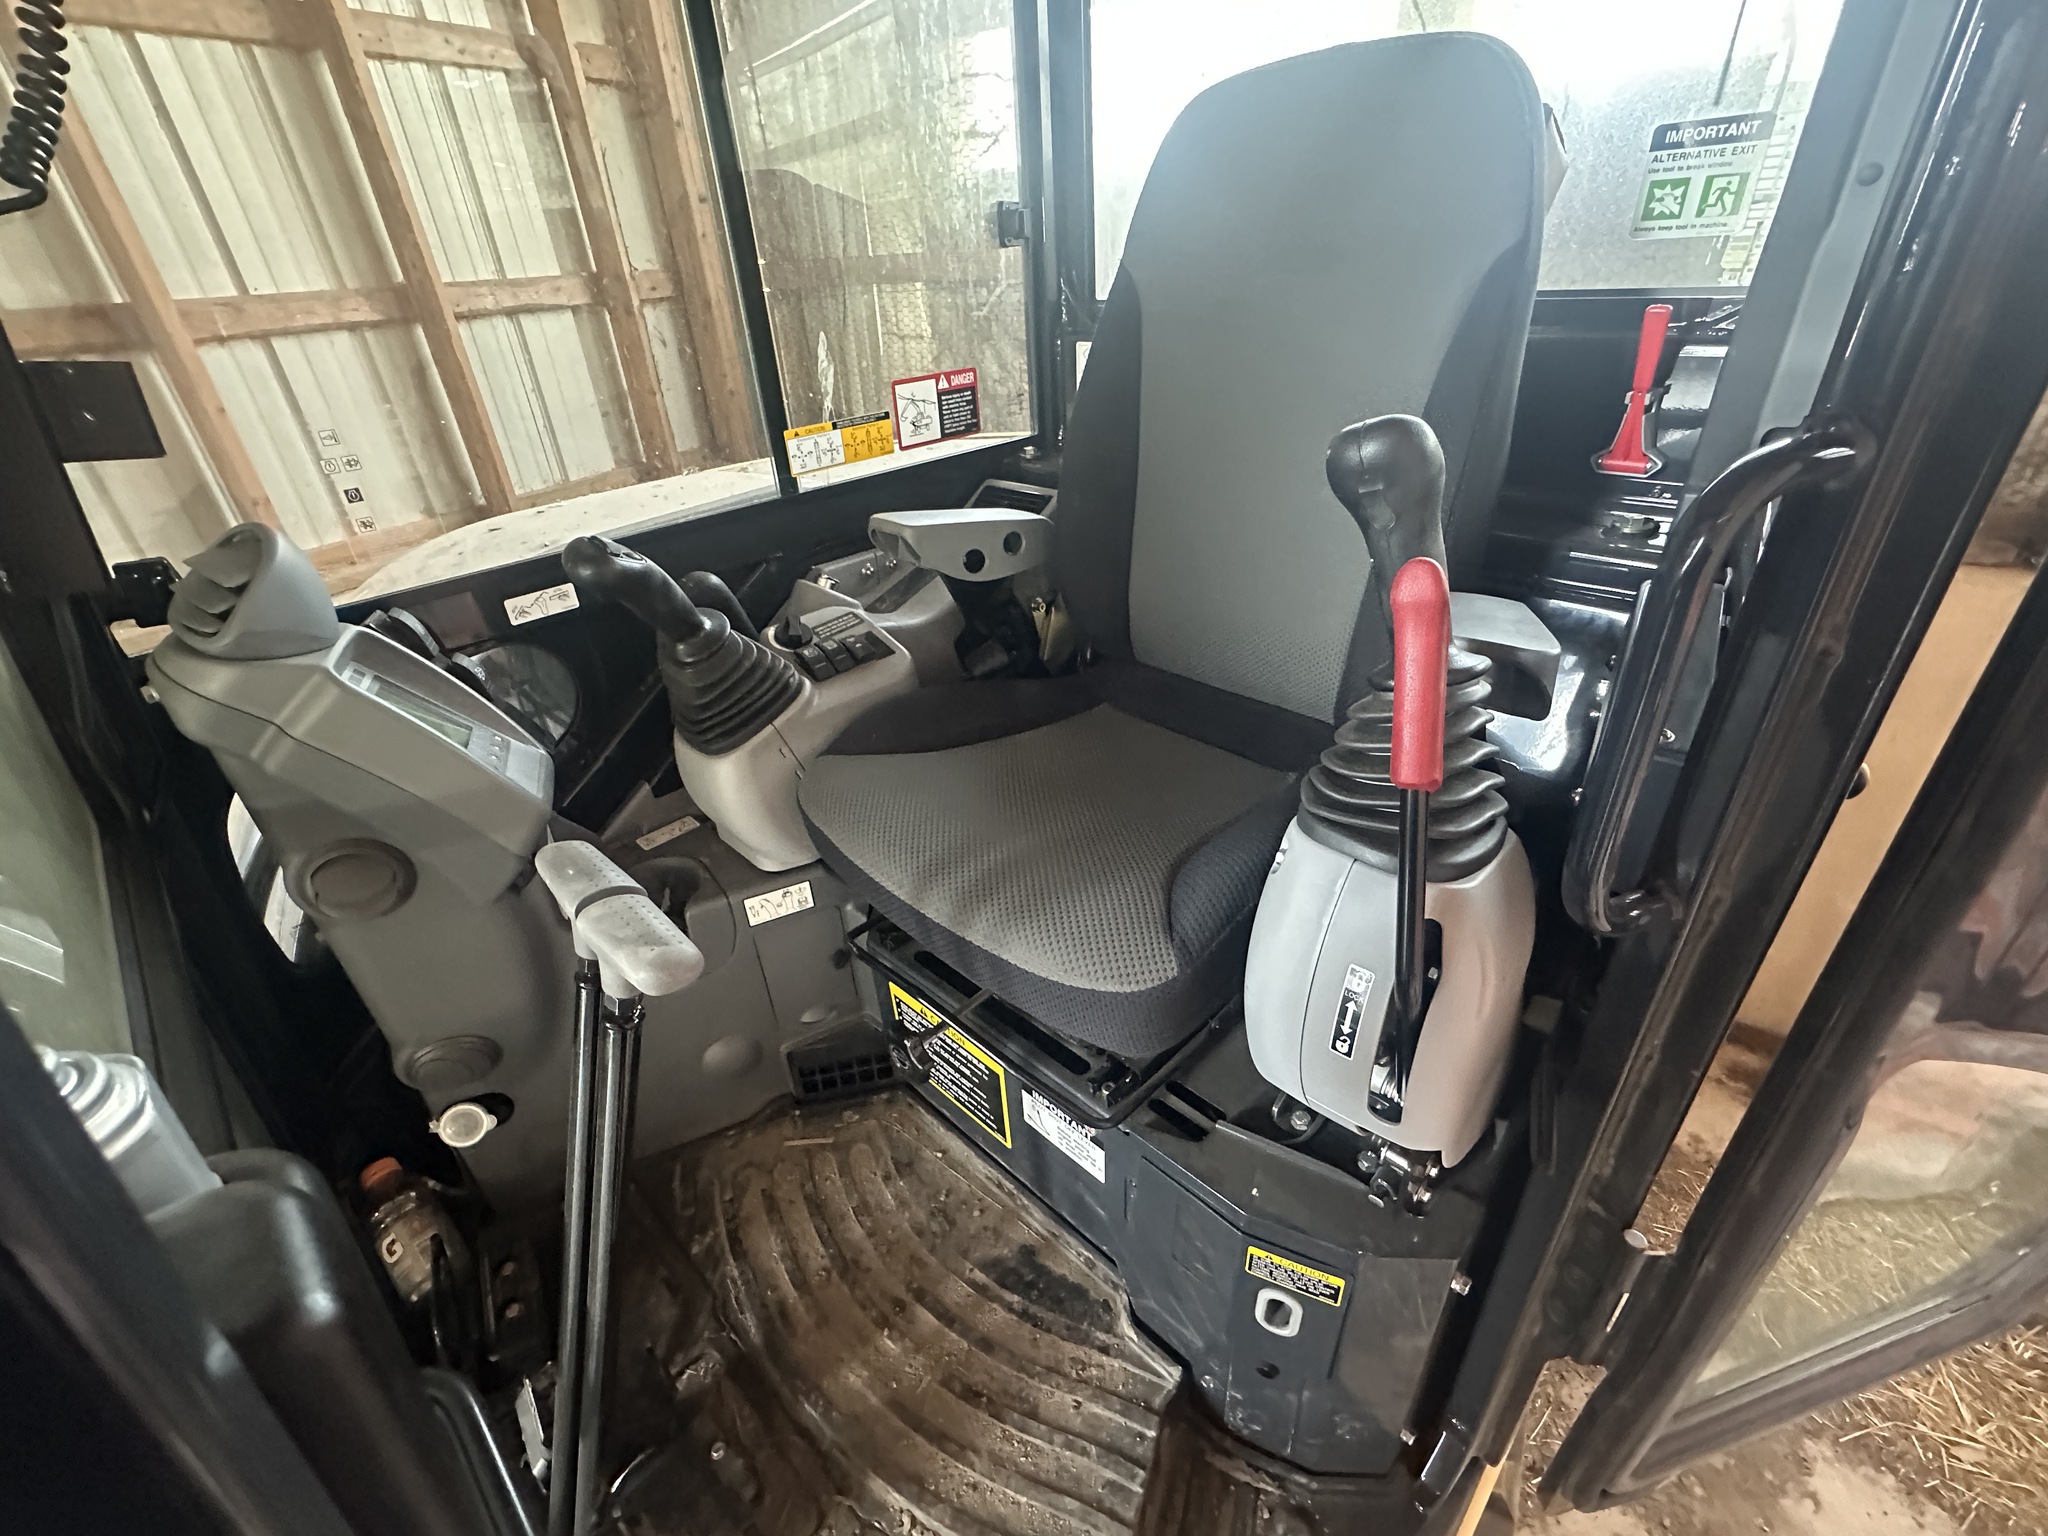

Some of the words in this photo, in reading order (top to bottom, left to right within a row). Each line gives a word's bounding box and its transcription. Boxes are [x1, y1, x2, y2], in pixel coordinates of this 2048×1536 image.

[1665, 120, 1762, 144] IMPORTANT
[1651, 147, 1727, 164] ALTERNATIVE
[1731, 144, 1758, 156] EXIT
[950, 371, 975, 387] DANGER
[805, 425, 826, 435] CAUTION
[1344, 990, 1365, 1005] LOCK
[1031, 1090, 1093, 1142] IMPORTANT
[381, 1232, 404, 1263] G
[1279, 1259, 1330, 1281] CAUTION
